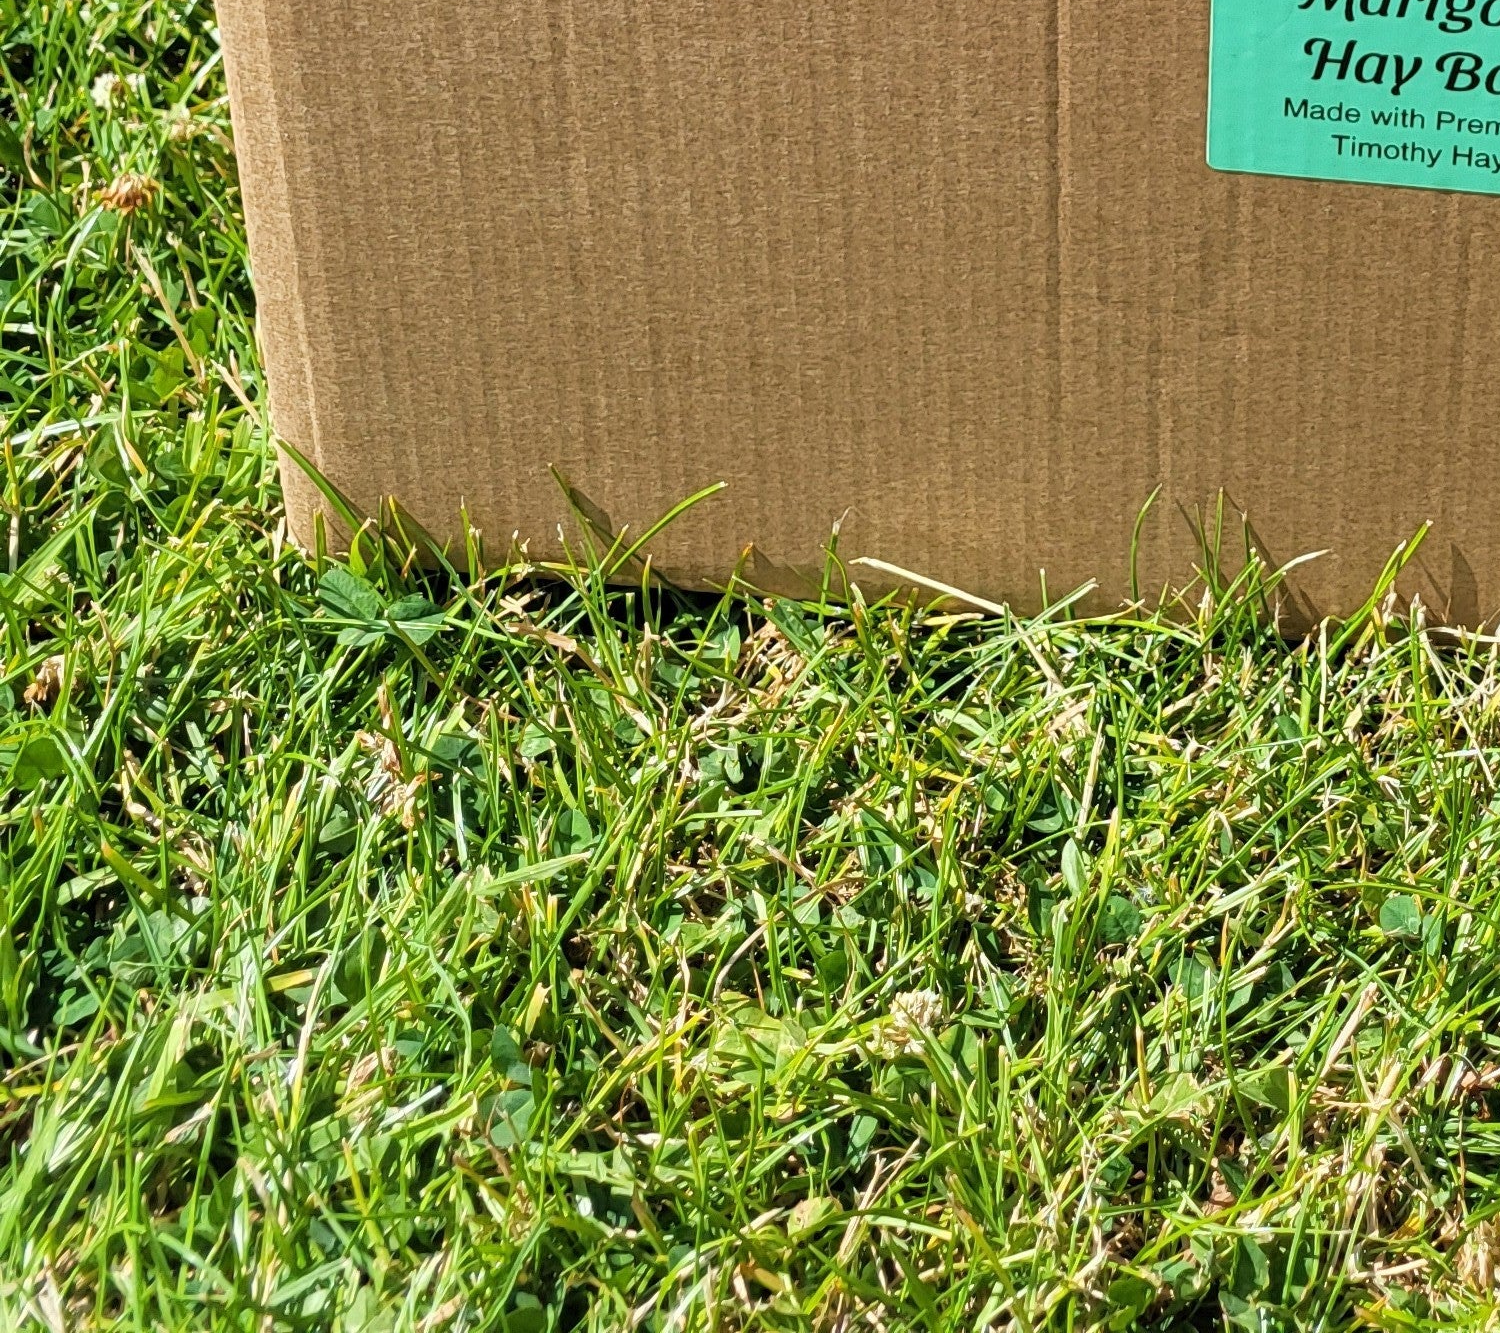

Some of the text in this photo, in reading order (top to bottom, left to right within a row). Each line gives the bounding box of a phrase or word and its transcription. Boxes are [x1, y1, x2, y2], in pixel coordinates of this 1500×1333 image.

[1303, 37, 1423, 96] Hay
[1283, 97, 1361, 124] Made
[1370, 106, 1426, 130] with
[1331, 134, 1442, 168] Timothy
